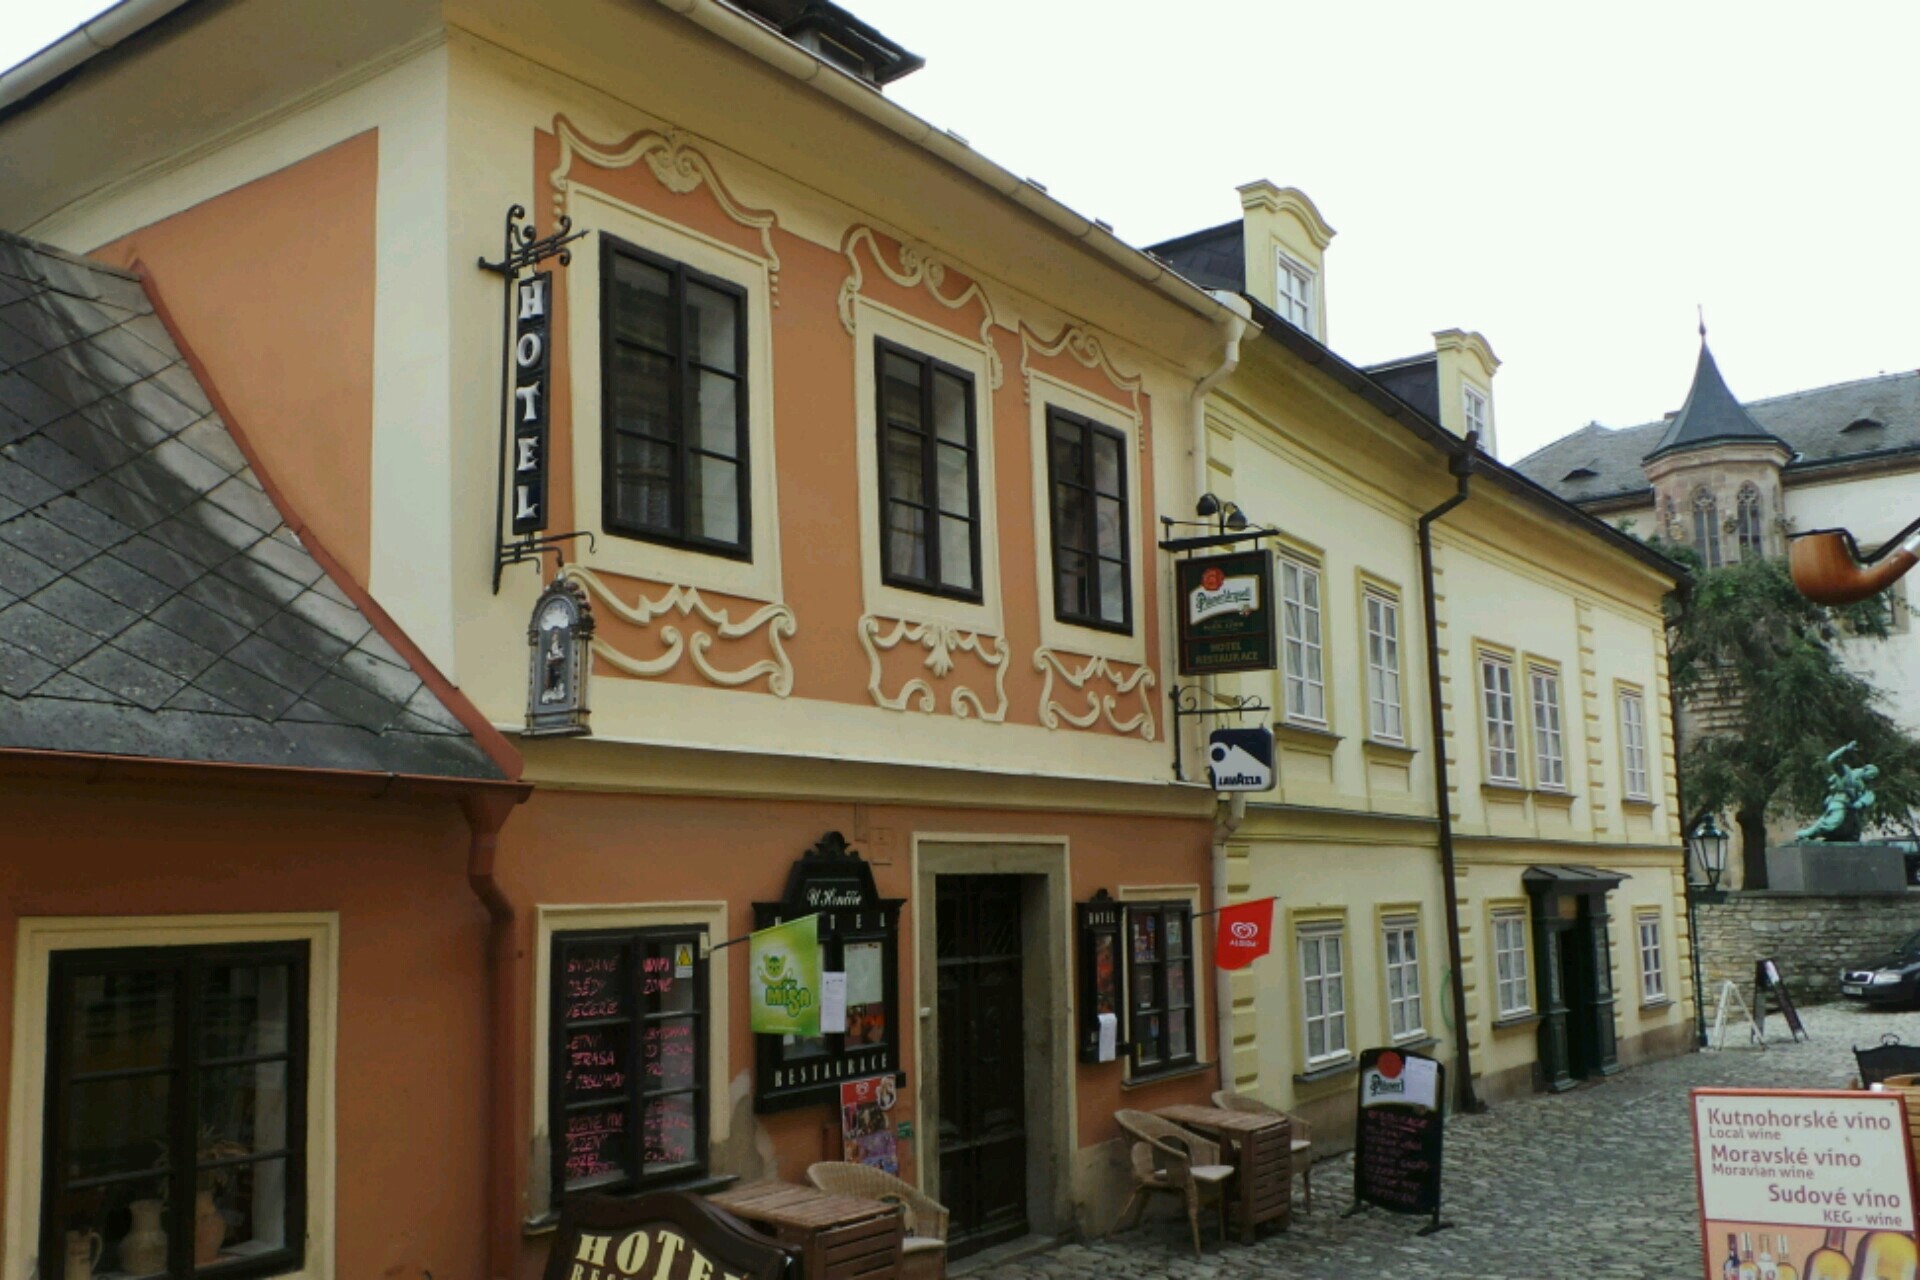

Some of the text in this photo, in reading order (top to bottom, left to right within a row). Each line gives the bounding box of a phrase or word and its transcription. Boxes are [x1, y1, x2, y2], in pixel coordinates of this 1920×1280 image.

[515, 280, 545, 520] HOTEL
[1218, 772, 1262, 786] LAVAZZA
[774, 912, 886, 930] HTEL
[774, 1053, 888, 1088] RESTAURACE
[1707, 1108, 1891, 1130] Kutnohorské víno
[1709, 1126, 1781, 1140] Local wine
[1711, 1144, 1861, 1167] Moravské víno
[1712, 1163, 1815, 1179] Moravian wine
[1768, 1184, 1900, 1208] Sudové víno
[1824, 1210, 1853, 1223] KEG
[1866, 1212, 1902, 1226] wine
[575, 1230, 748, 1280] HOTE
